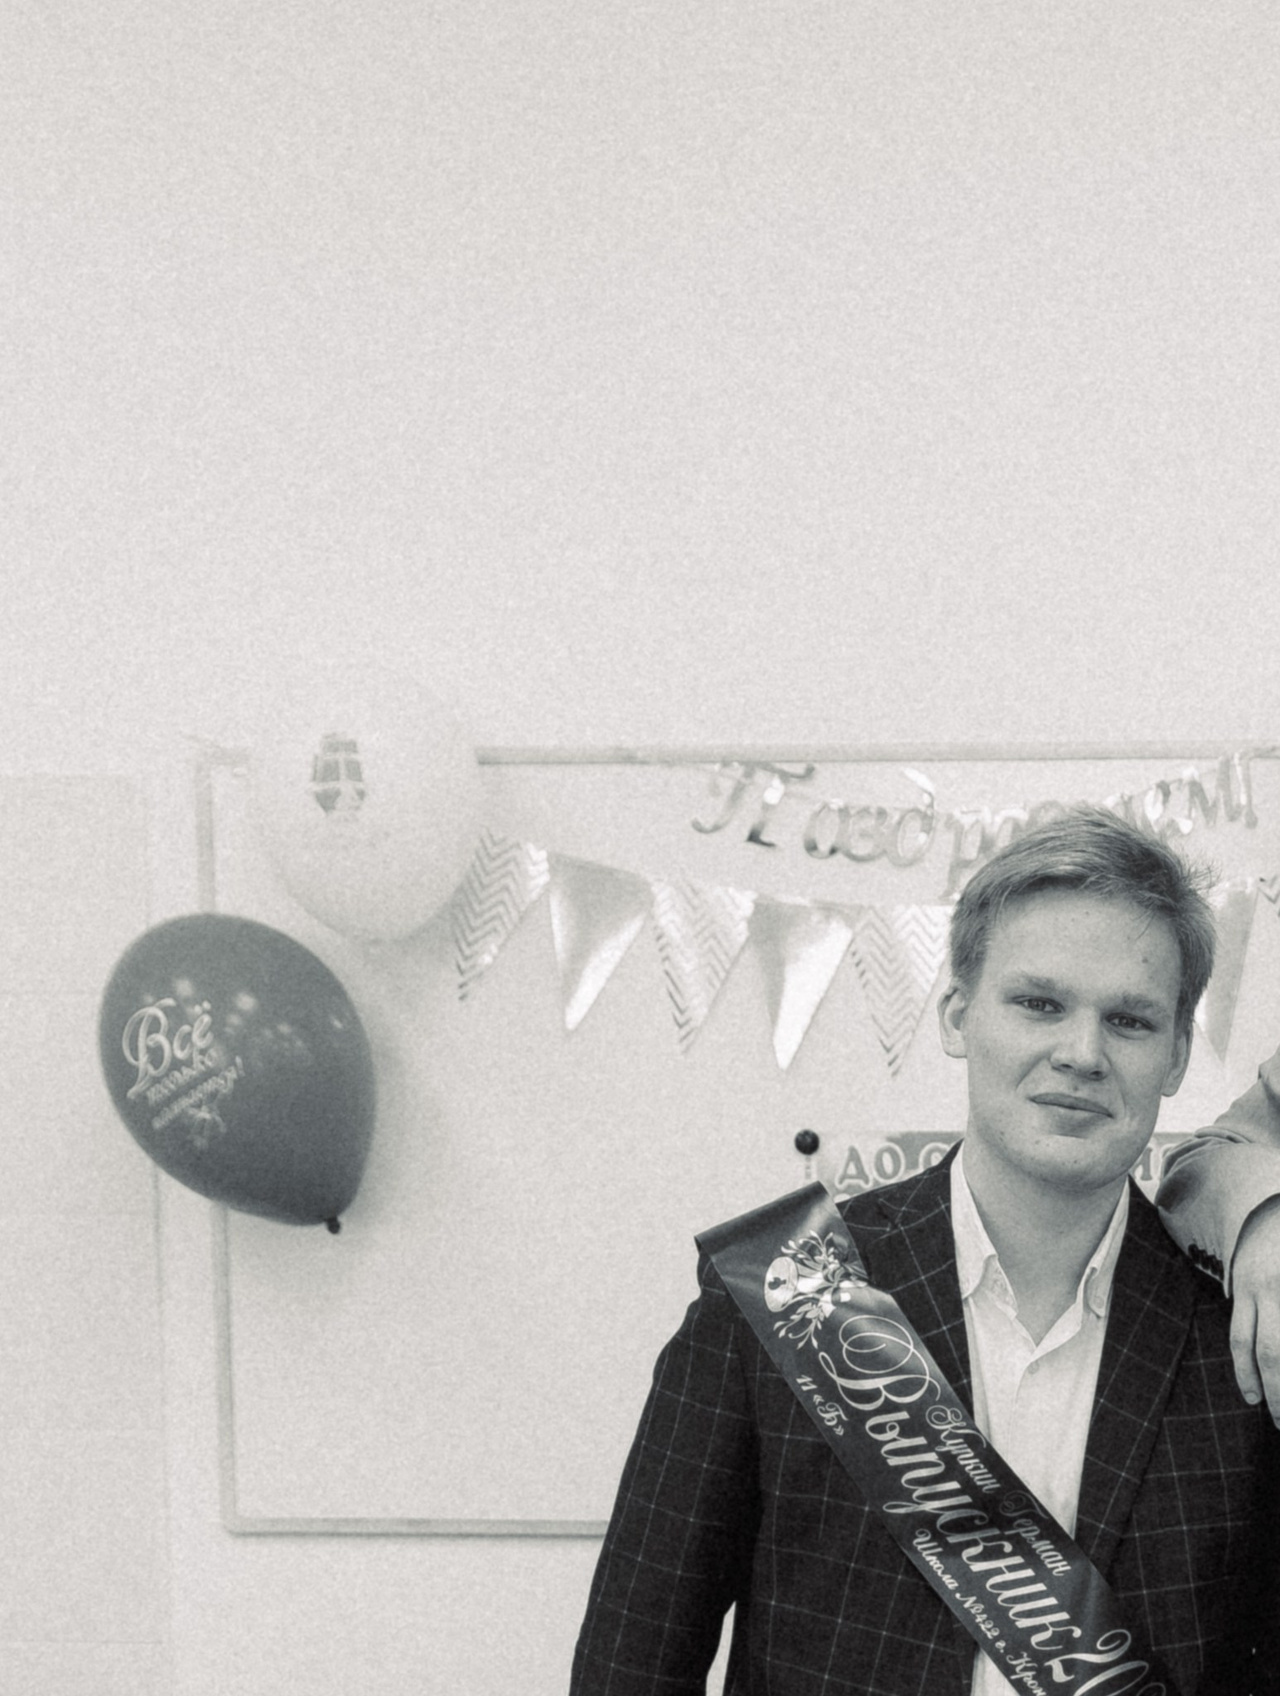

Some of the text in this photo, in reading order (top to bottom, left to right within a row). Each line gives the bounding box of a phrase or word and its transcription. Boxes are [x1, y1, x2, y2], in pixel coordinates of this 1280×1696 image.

[691, 752, 1256, 898] Поздрем
[122, 998, 213, 1099] Всё
[795, 1375, 818, 1391] 11
[819, 1315, 1082, 1651] Выпускник
[925, 1405, 1074, 1577] Купкин Герман
[912, 1529, 959, 1591] Школа
